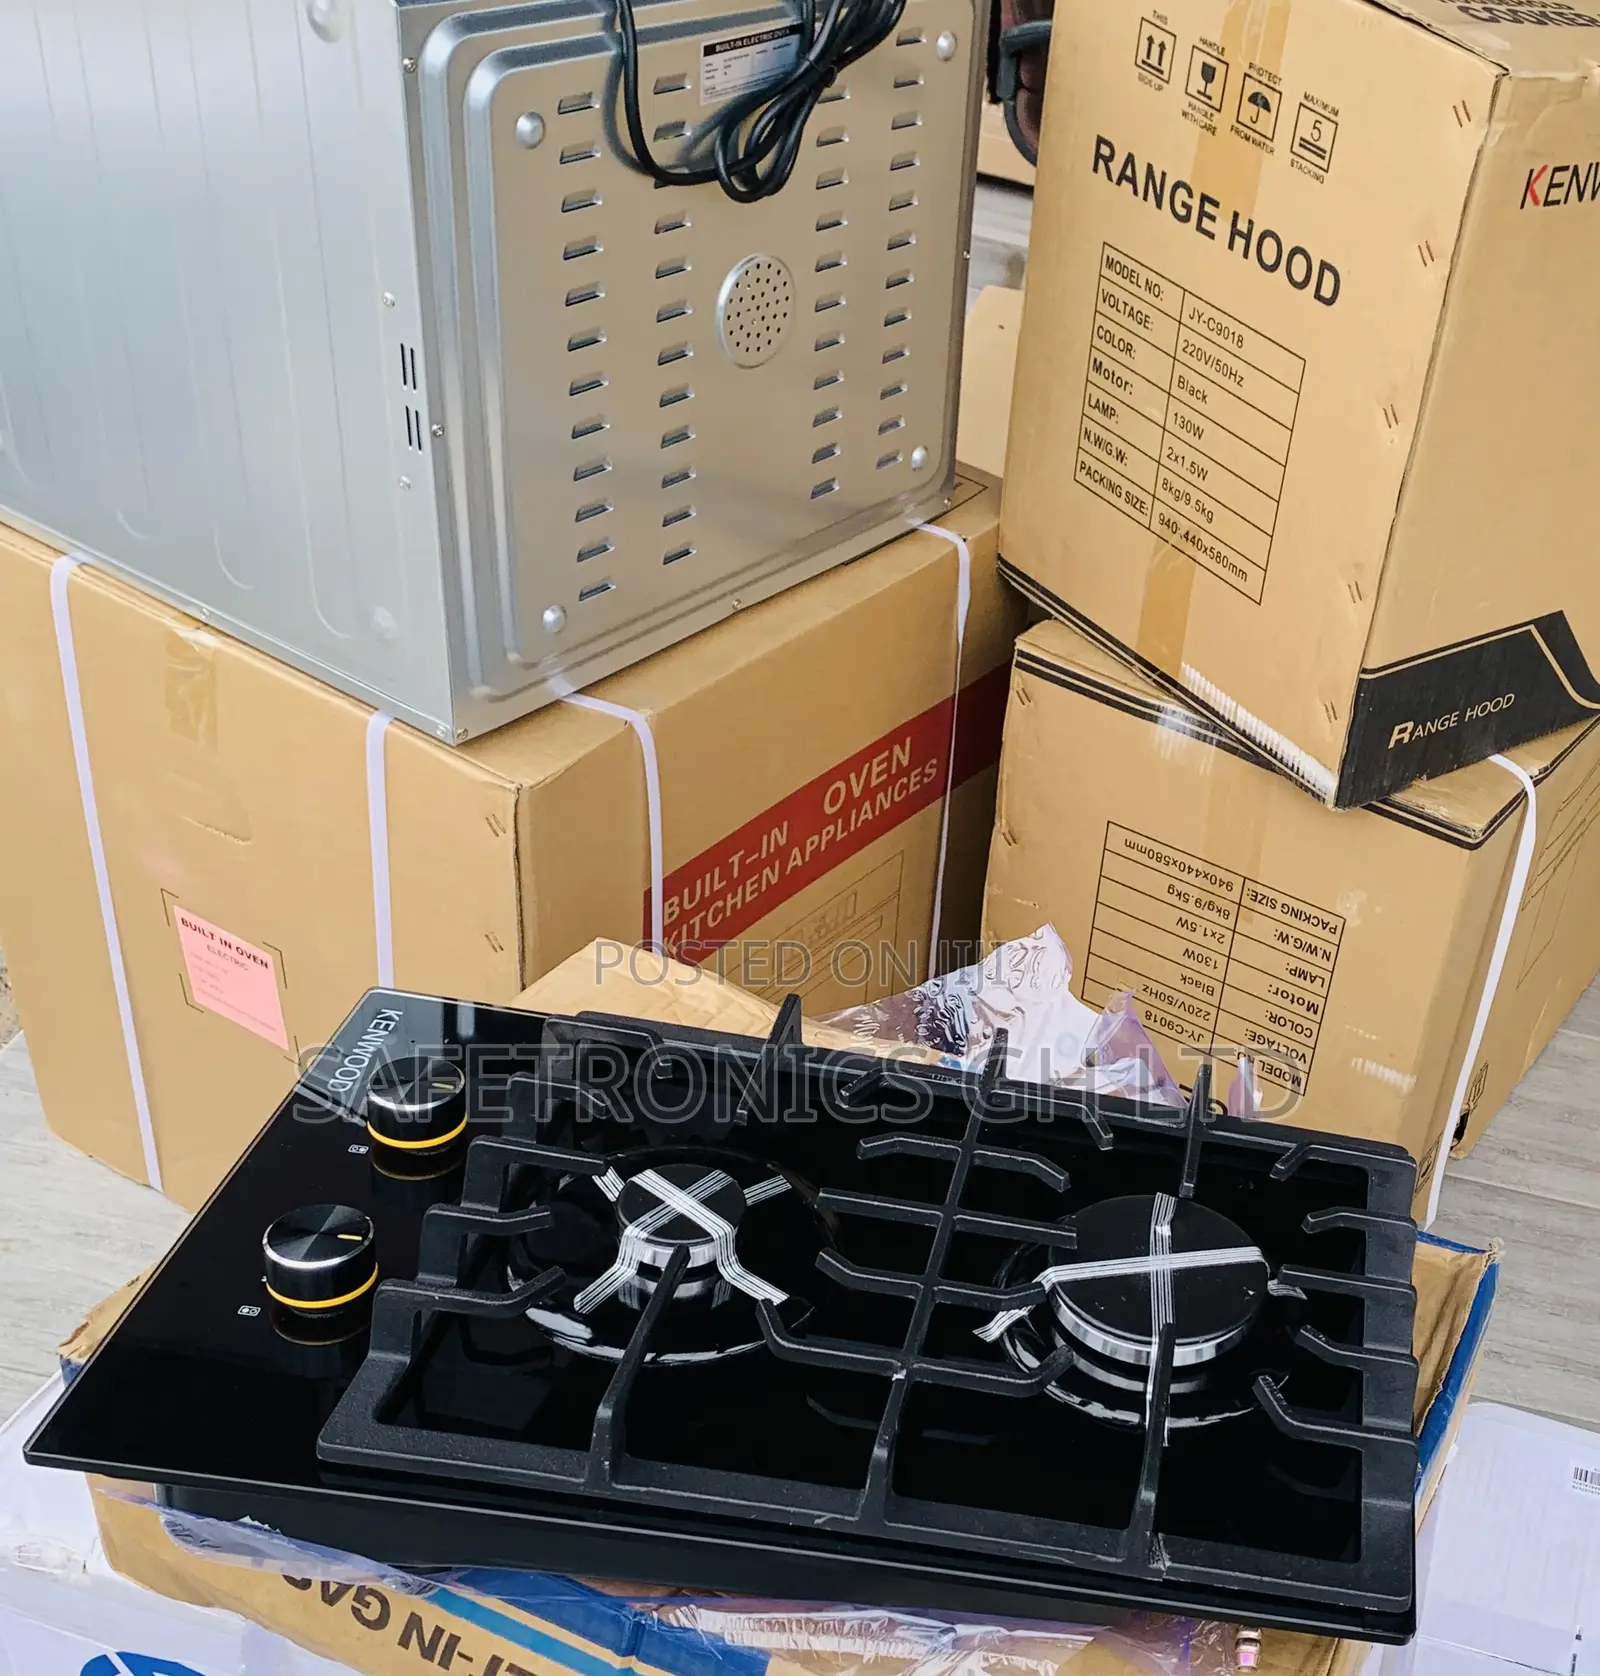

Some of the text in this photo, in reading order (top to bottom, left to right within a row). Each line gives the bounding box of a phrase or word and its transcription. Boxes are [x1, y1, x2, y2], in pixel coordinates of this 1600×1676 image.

[1153, 9, 1168, 25] THIS
[1199, 36, 1225, 57] HANDLE
[1138, 72, 1164, 92] SIDE UP
[1248, 62, 1282, 85] PROTECT
[1303, 91, 1339, 117] MAXIMUM
[1230, 124, 1275, 156] FROM WATER
[1310, 120, 1322, 142] 5
[1290, 158, 1324, 184] STACKING
[1092, 134, 1341, 306] RANGE HOOD
[1105, 254, 1164, 301] MODEL NO:
[1102, 288, 1154, 332] VOLTAGE:
[1096, 325, 1136, 360] COLOR:
[1189, 306, 1244, 349] JY-C9018
[1092, 357, 1134, 396] Motor:
[1182, 339, 1244, 388] 220V/50Hz
[1178, 375, 1208, 404] Black
[1088, 393, 1119, 424] LAMP:
[1173, 412, 1204, 441] 130W
[1084, 427, 1128, 466] N.W/G.W:
[1166, 446, 1209, 481] 2x1.5W
[1080, 460, 1149, 517] PACKING SIZE:
[1162, 478, 1214, 524] 8kg/9.5kg
[1388, 693, 1515, 749] RANGE HOOD
[664, 737, 912, 925] BUILT-IN OVEN
[663, 758, 937, 954] KITCHEN APPLIANCES
[1124, 838, 1234, 892] 940x440x580mm
[1167, 884, 1230, 920] 8kg/9.5kg
[1246, 887, 1338, 935] PACKING SIZE:
[181, 917, 215, 941] BUILT
[220, 937, 232, 950] IN
[236, 946, 268, 970] OVEN
[1176, 916, 1226, 944] 2x1.5W
[1274, 928, 1332, 962] N.W/G.W:
[207, 944, 248, 971] ELECTRIC
[1183, 948, 1218, 970] 130W
[1180, 973, 1214, 997] Black
[1286, 962, 1326, 988] LAMP:
[1142, 983, 1211, 1022] 220V/50Hz
[1268, 983, 1319, 1016] Motor:
[1144, 1010, 1204, 1042] JY-C9018
[1265, 1009, 1313, 1039] COLOR:
[327, 1008, 404, 1092] KENWOOD
[1244, 1028, 1306, 1064] VOLTAGE:
[1258, 1060, 1302, 1088] MODEL
